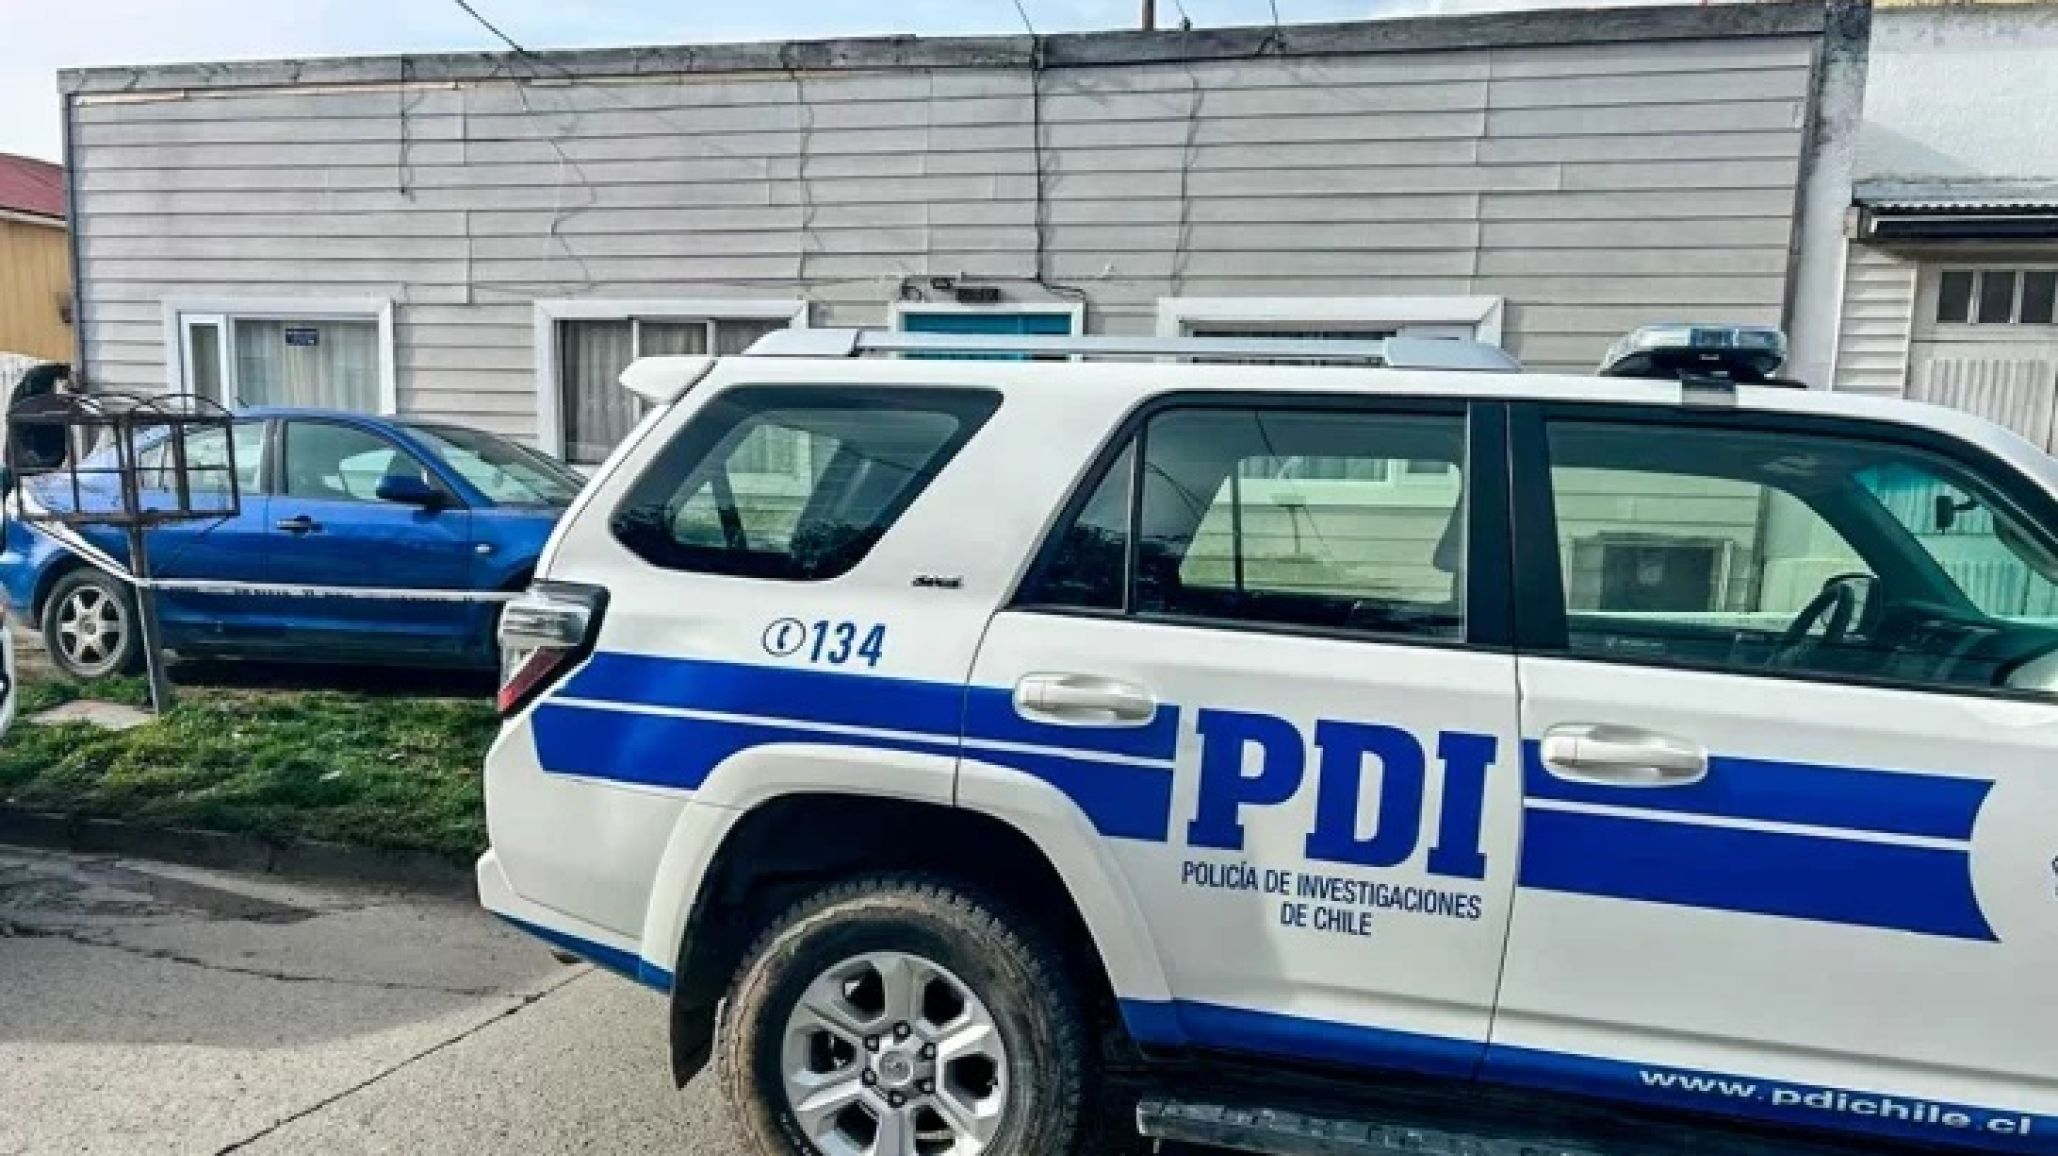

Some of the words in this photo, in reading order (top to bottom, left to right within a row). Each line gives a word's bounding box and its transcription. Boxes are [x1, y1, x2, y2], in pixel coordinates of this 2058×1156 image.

[810, 619, 886, 668] 134
[1186, 707, 1499, 881] PDI
[1181, 860, 1258, 890] POLICÍA
[1263, 869, 1292, 895] DE
[1297, 873, 1482, 920] INVESTIGACIONES
[1280, 902, 1307, 927] DE
[1313, 906, 1373, 936] CHILE
[1639, 1069, 2031, 1136] www.pdichile.cl
